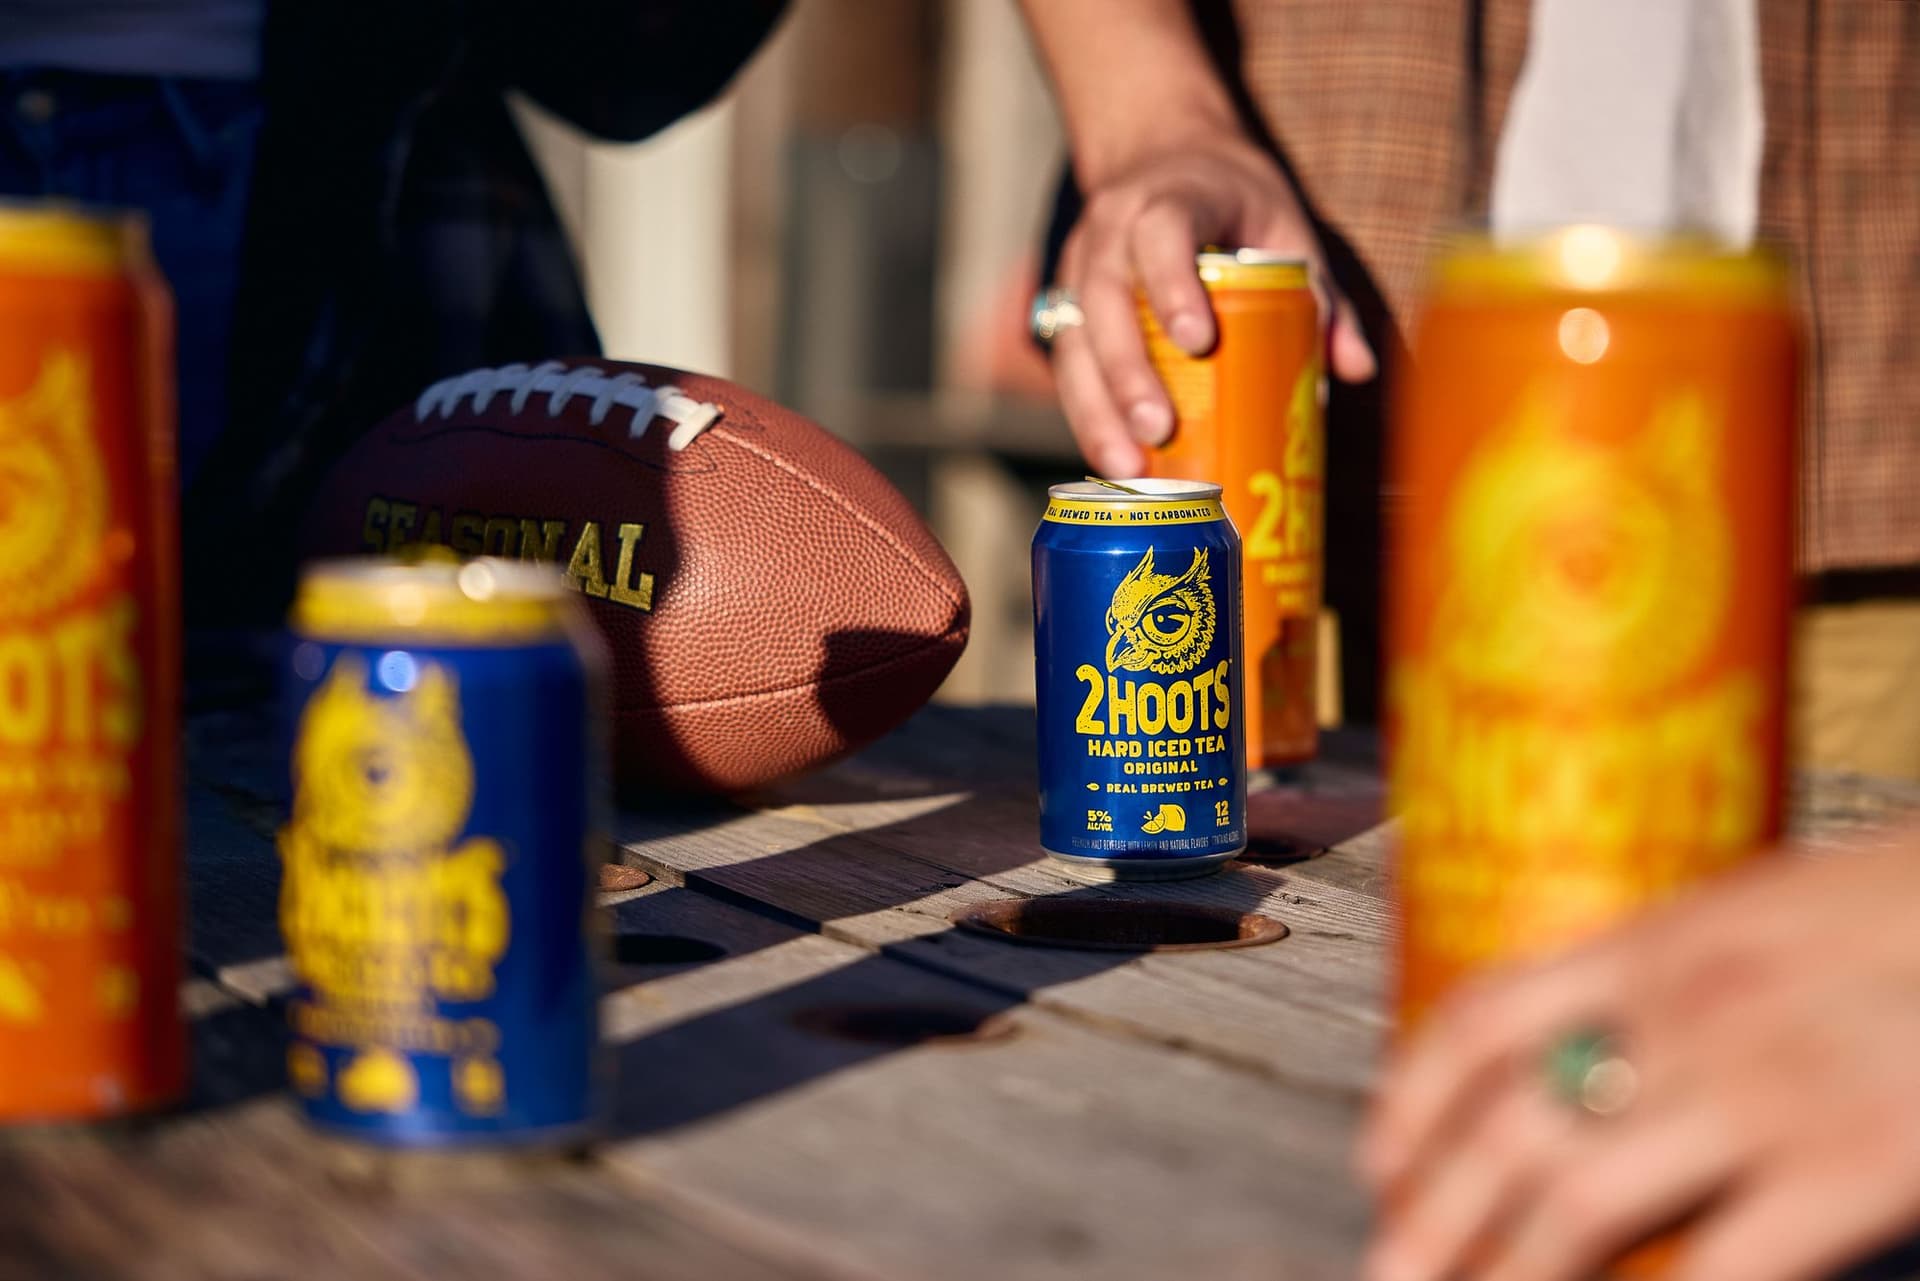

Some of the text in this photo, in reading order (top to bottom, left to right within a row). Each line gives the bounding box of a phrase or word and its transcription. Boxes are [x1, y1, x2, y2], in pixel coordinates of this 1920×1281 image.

[1059, 507, 1089, 520] BREWED
[1094, 511, 1112, 521] TEA
[1130, 511, 1150, 521] NOT
[1154, 507, 1211, 520] CARBONATED
[363, 497, 655, 612] SEASONAL
[1075, 660, 1230, 736] 2HOOTS
[1088, 735, 1226, 758] HARD ICED TEA
[1123, 760, 1199, 775] ORIGINAL
[1106, 780, 1214, 793] REAL BREWED TEA
[1087, 809, 1112, 823] 5%
[1214, 800, 1230, 817] 12
[1170, 838, 1190, 850] NATURAL
